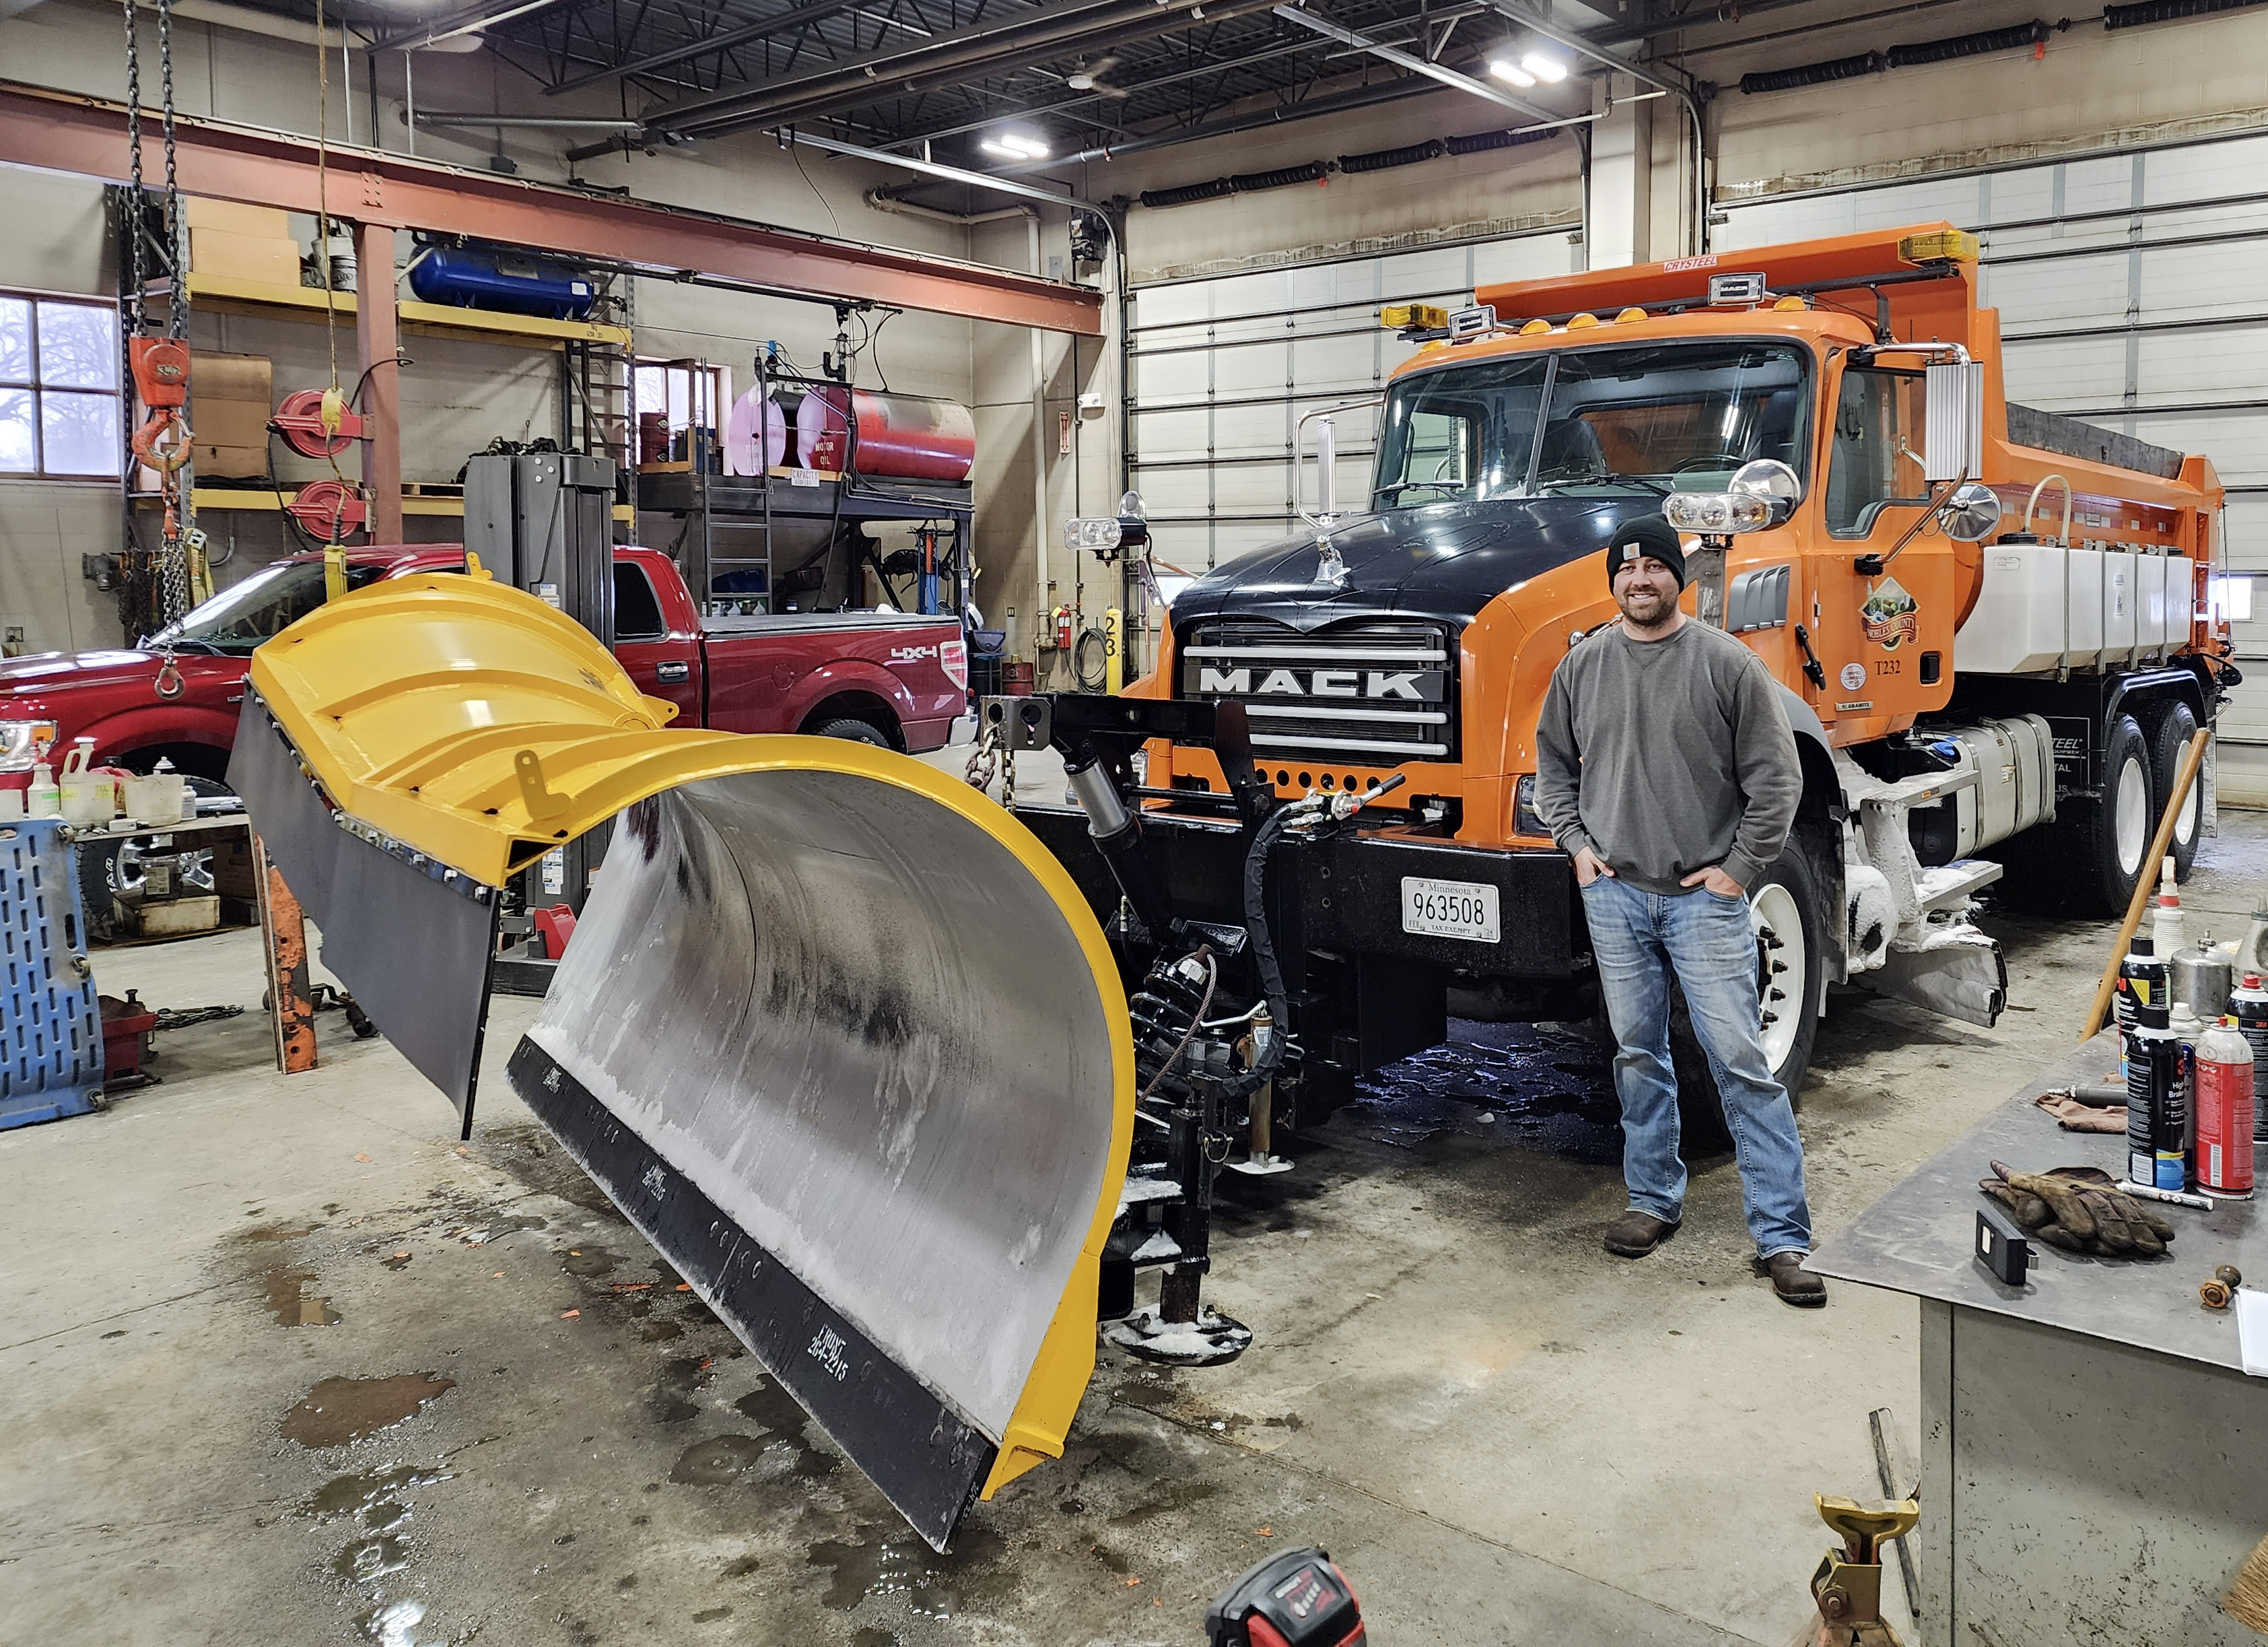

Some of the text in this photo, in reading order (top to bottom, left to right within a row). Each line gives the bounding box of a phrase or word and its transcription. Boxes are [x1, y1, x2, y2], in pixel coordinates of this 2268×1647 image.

[1665, 256, 1716, 271] CRYSTEEL
[815, 442, 834, 452] MOTOR
[820, 456, 831, 465] OIL
[792, 470, 818, 479] CAPACITY
[1867, 617, 1915, 639] NOBLES COUNTY
[1875, 660, 1900, 675] T232
[1200, 668, 1424, 700] MACK
[1429, 883, 1471, 896] Minnesota
[1414, 893, 1484, 925] 963508
[1409, 920, 1420, 928] FEB
[1445, 926, 1471, 935] EXEMPT
[807, 1336, 849, 1382] 264-2215
